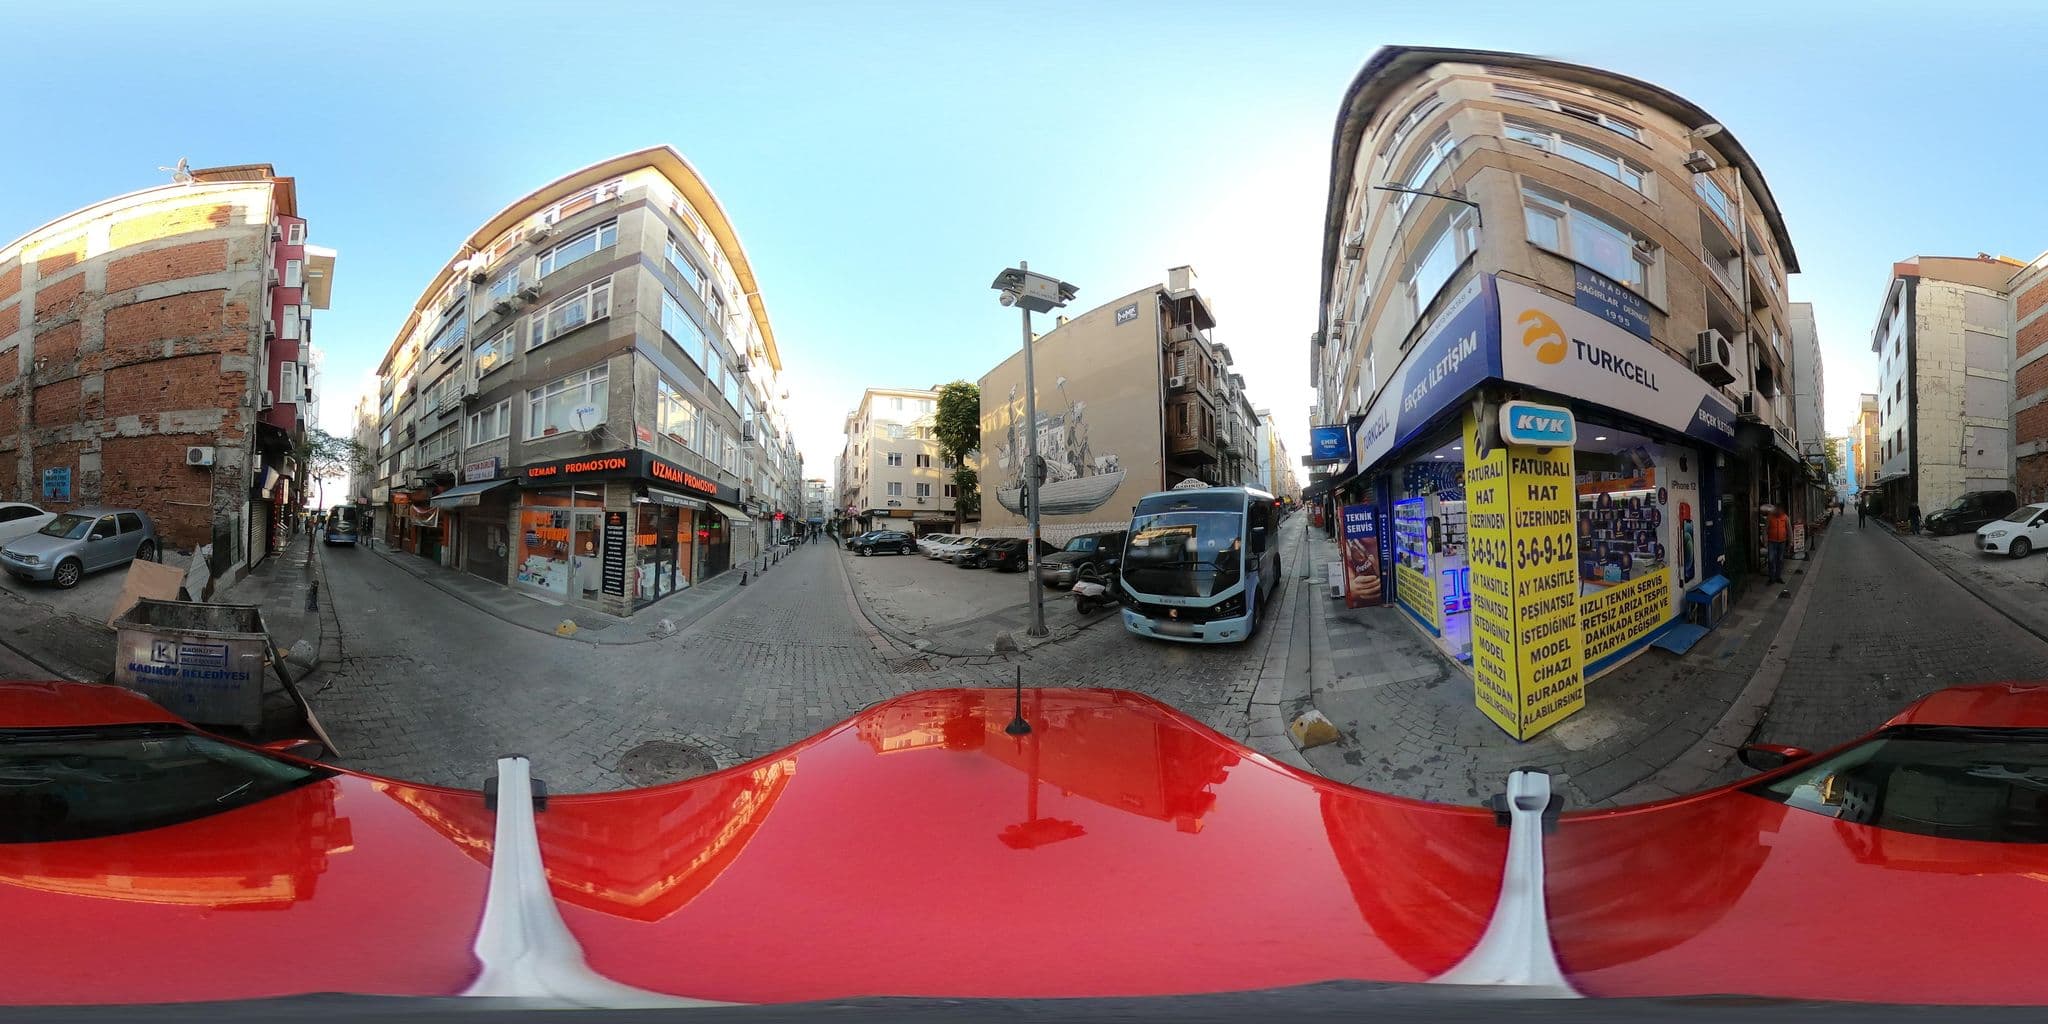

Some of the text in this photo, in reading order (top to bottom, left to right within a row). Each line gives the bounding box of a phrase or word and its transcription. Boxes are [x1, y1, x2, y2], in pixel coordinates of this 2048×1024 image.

[1590, 275, 1640, 307] ANADOLU
[1404, 330, 1477, 413] ERÇEK İLETİŞİM
[1572, 338, 1660, 392] TURKCELL
[1517, 414, 1566, 433] KVK
[528, 457, 627, 477] UZMAN PROMOSYON
[652, 460, 718, 496] UZMAN PROMOSYON
[1467, 460, 1504, 483] FATURALI
[1512, 458, 1570, 477] FATURALI
[1476, 488, 1495, 505] HAT
[1528, 484, 1558, 501] HAT
[1671, 480, 1697, 491] iPhone 12
[1345, 511, 1372, 522] TEKNİK
[1347, 522, 1373, 533] SERVİS
[1515, 506, 1571, 529] ÜZERİNDEN
[1471, 537, 1507, 569] 3-6-9-12
[1517, 533, 1573, 569] 3-6-9-12
[1519, 569, 1574, 597] AY TAKSİTLE
[1605, 584, 1636, 606] TEKNİK
[1637, 574, 1662, 594] SERVİS
[1580, 606, 1617, 632] RETSİZ
[1619, 597, 1642, 616] ARIZA
[1585, 597, 1668, 645] DAKİKADA EKRAN VE
[1521, 611, 1576, 646] İSTEDİĞİNİZ
[1479, 636, 1505, 663] MODEL
[1530, 638, 1571, 664] MODEL
[1584, 632, 1626, 659] BATARYA
[128, 662, 249, 681] KADIKÖY BELEDİYESİ
[1533, 657, 1571, 683] CİHAZI
[1477, 671, 1513, 704] BURADAN
[1527, 672, 1578, 707] BURADAN
